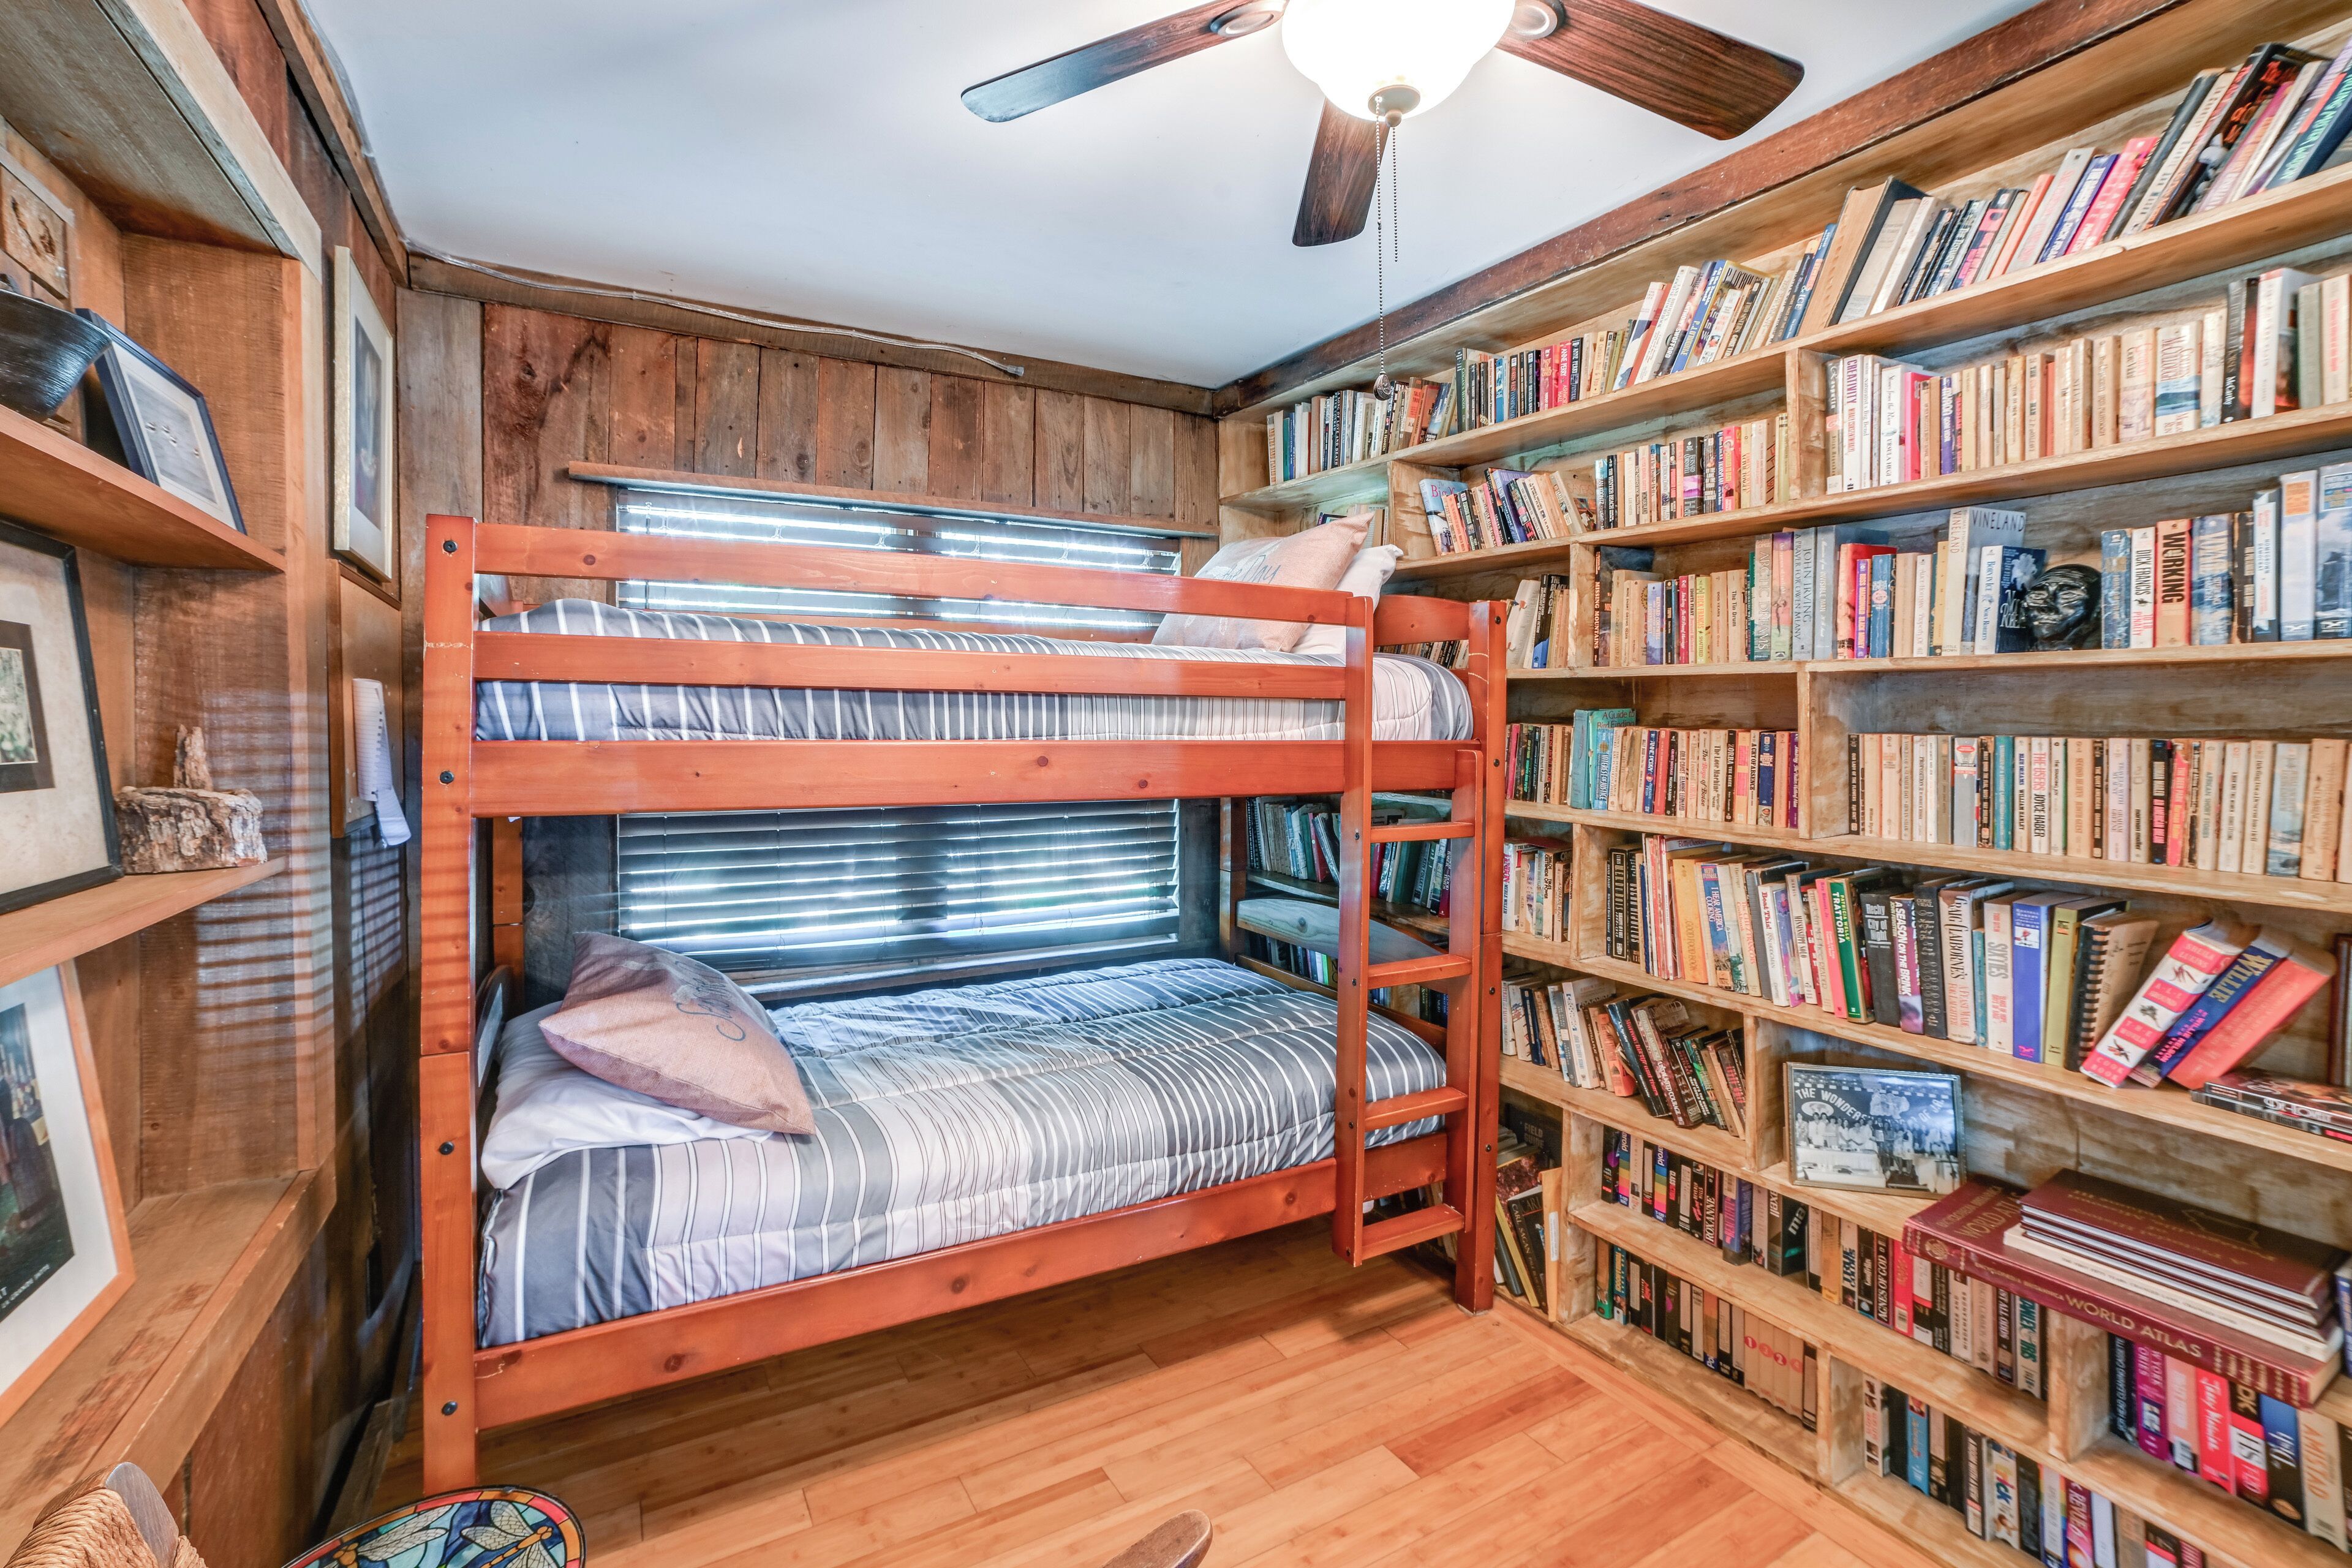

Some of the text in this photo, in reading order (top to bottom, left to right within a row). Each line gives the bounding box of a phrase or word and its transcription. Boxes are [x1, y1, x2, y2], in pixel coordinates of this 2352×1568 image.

[1678, 301, 1691, 329] ANTHONY
[1795, 294, 1806, 309] ICE
[1664, 328, 1681, 358] SWOFFORD
[1846, 360, 1857, 404] CREATIVITY
[1950, 511, 1962, 554] VINELAND
[1972, 511, 2026, 532] VINELAND
[1244, 554, 1281, 584] Day
[1803, 549, 1812, 622] JOHN IRVING
[2135, 549, 2152, 595] DICK FRANCIS
[2162, 531, 2185, 603] WORKING
[1758, 552, 1770, 650] ARCTIC DREAMS
[2034, 753, 2046, 791] THE USERS
[2153, 761, 2165, 796] NORMAN MAILER
[2034, 794, 2045, 837] JOYCE HABER
[1706, 896, 1714, 922] COOKING
[1711, 891, 1720, 906] HEAR
[1713, 907, 1723, 931] AMERICA
[1794, 915, 1804, 944] MISSISSIPPI
[1833, 892, 1845, 943] TRATTORIA
[1896, 907, 1907, 944] SEASON
[1944, 899, 1969, 979] CRAIG CLAIBORNE'S
[1898, 955, 1907, 968] THE
[1988, 942, 2009, 979] SIXTIES
[2211, 951, 2275, 1005] WILLIE
[1899, 968, 1911, 996] BRINK
[1796, 1088, 1816, 1100] THE
[1918, 1110, 1931, 1122] OF
[1512, 1203, 1523, 1225] CARL
[1518, 1227, 1531, 1254] SAGAN
[1705, 1196, 1716, 1242] ROXANNE
[1877, 1255, 1888, 1321] AGNES OF GOD
[2063, 1294, 2203, 1360] WORLD ATLAS
[2152, 1359, 2163, 1386] YORK
[2237, 1385, 2256, 1415] DK
[2303, 1423, 2328, 1500] AMISTAD
[2068, 1490, 2087, 1527] REVUE
